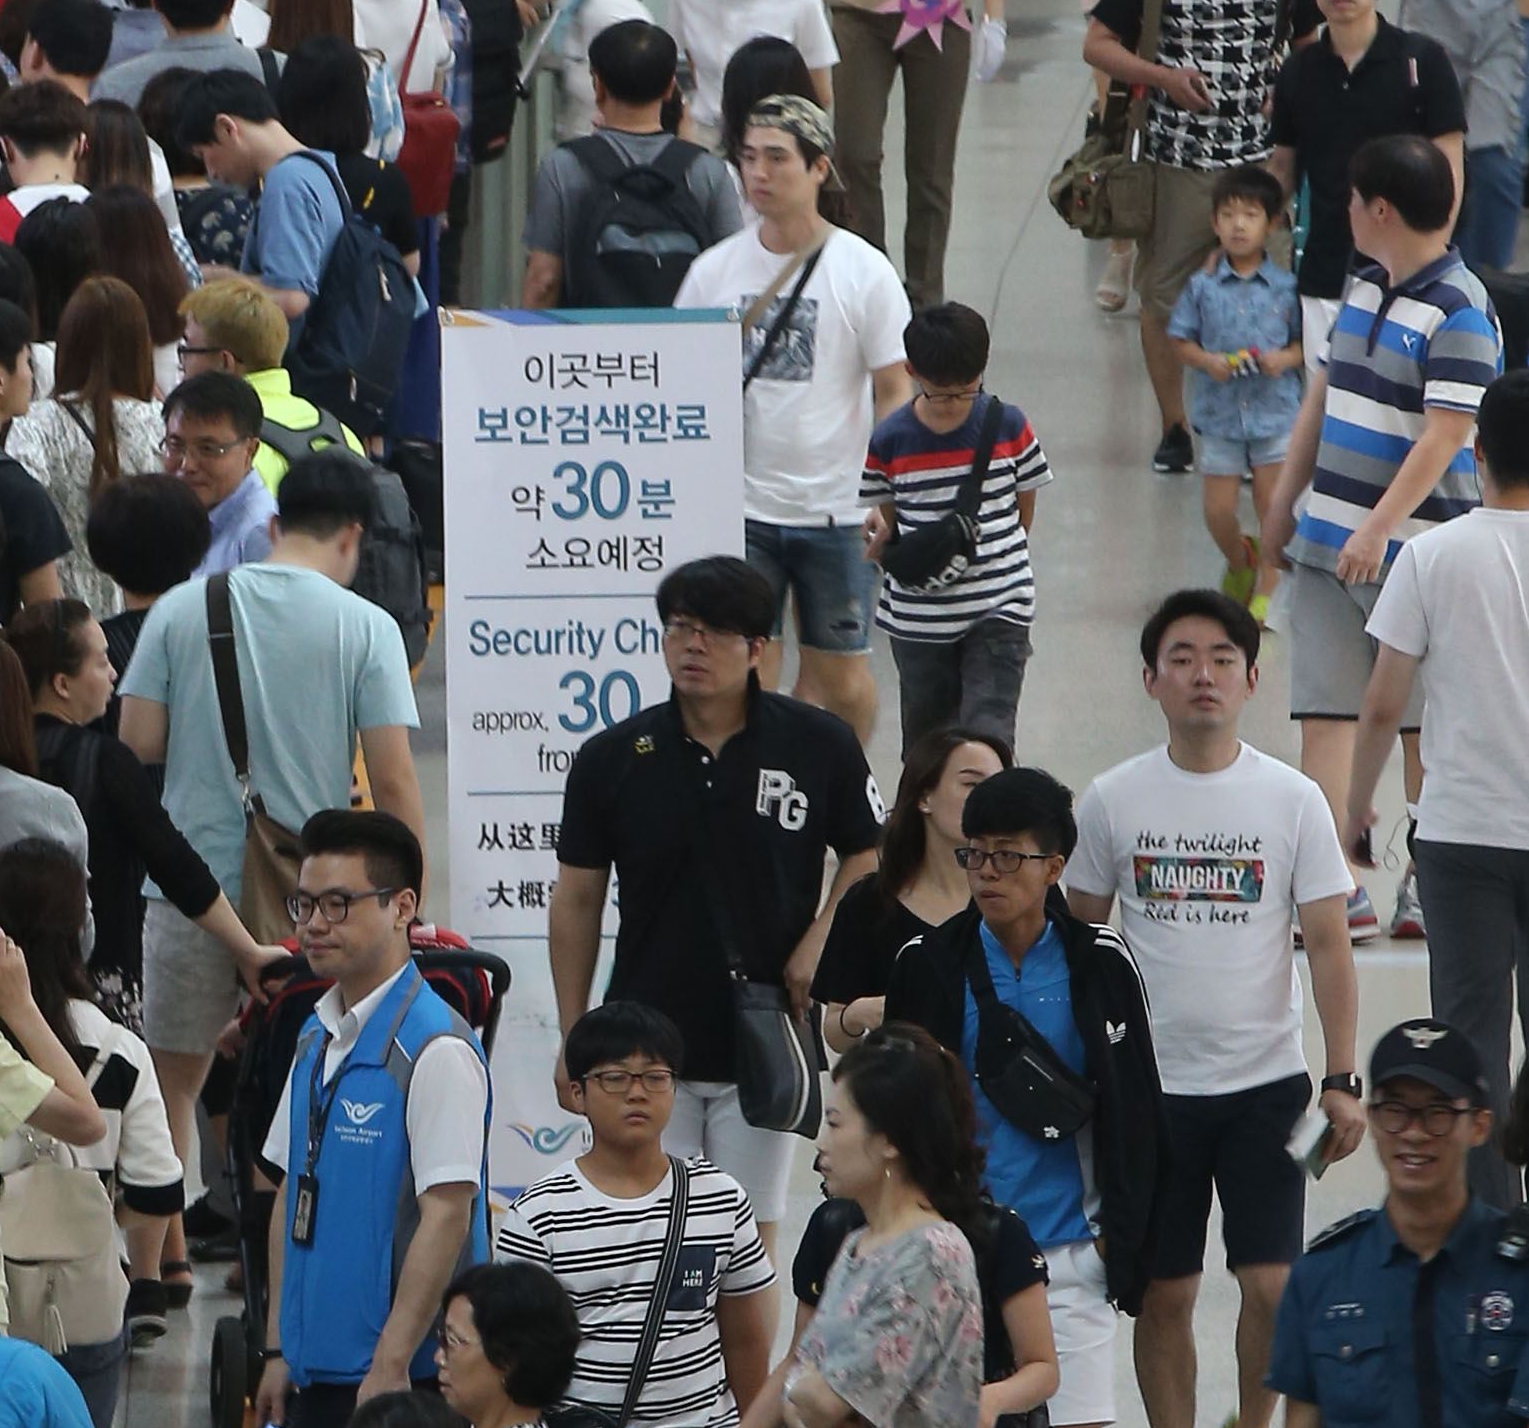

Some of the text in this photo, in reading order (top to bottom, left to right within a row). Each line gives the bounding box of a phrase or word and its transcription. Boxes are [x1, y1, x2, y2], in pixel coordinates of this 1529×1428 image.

[524, 351, 660, 389] 이곳부터
[474, 403, 711, 445] 보안검색완료
[510, 460, 676, 521] 약 30 분
[525, 534, 665, 572] 소요예정
[469, 620, 606, 661] Security
[472, 669, 642, 735] approx. 30
[1136, 830, 1263, 857] the twilight
[487, 879, 557, 909] 大概
[1150, 863, 1245, 891] NAUGHTY
[1186, 903, 1202, 924] is
[1209, 903, 1250, 925] here
